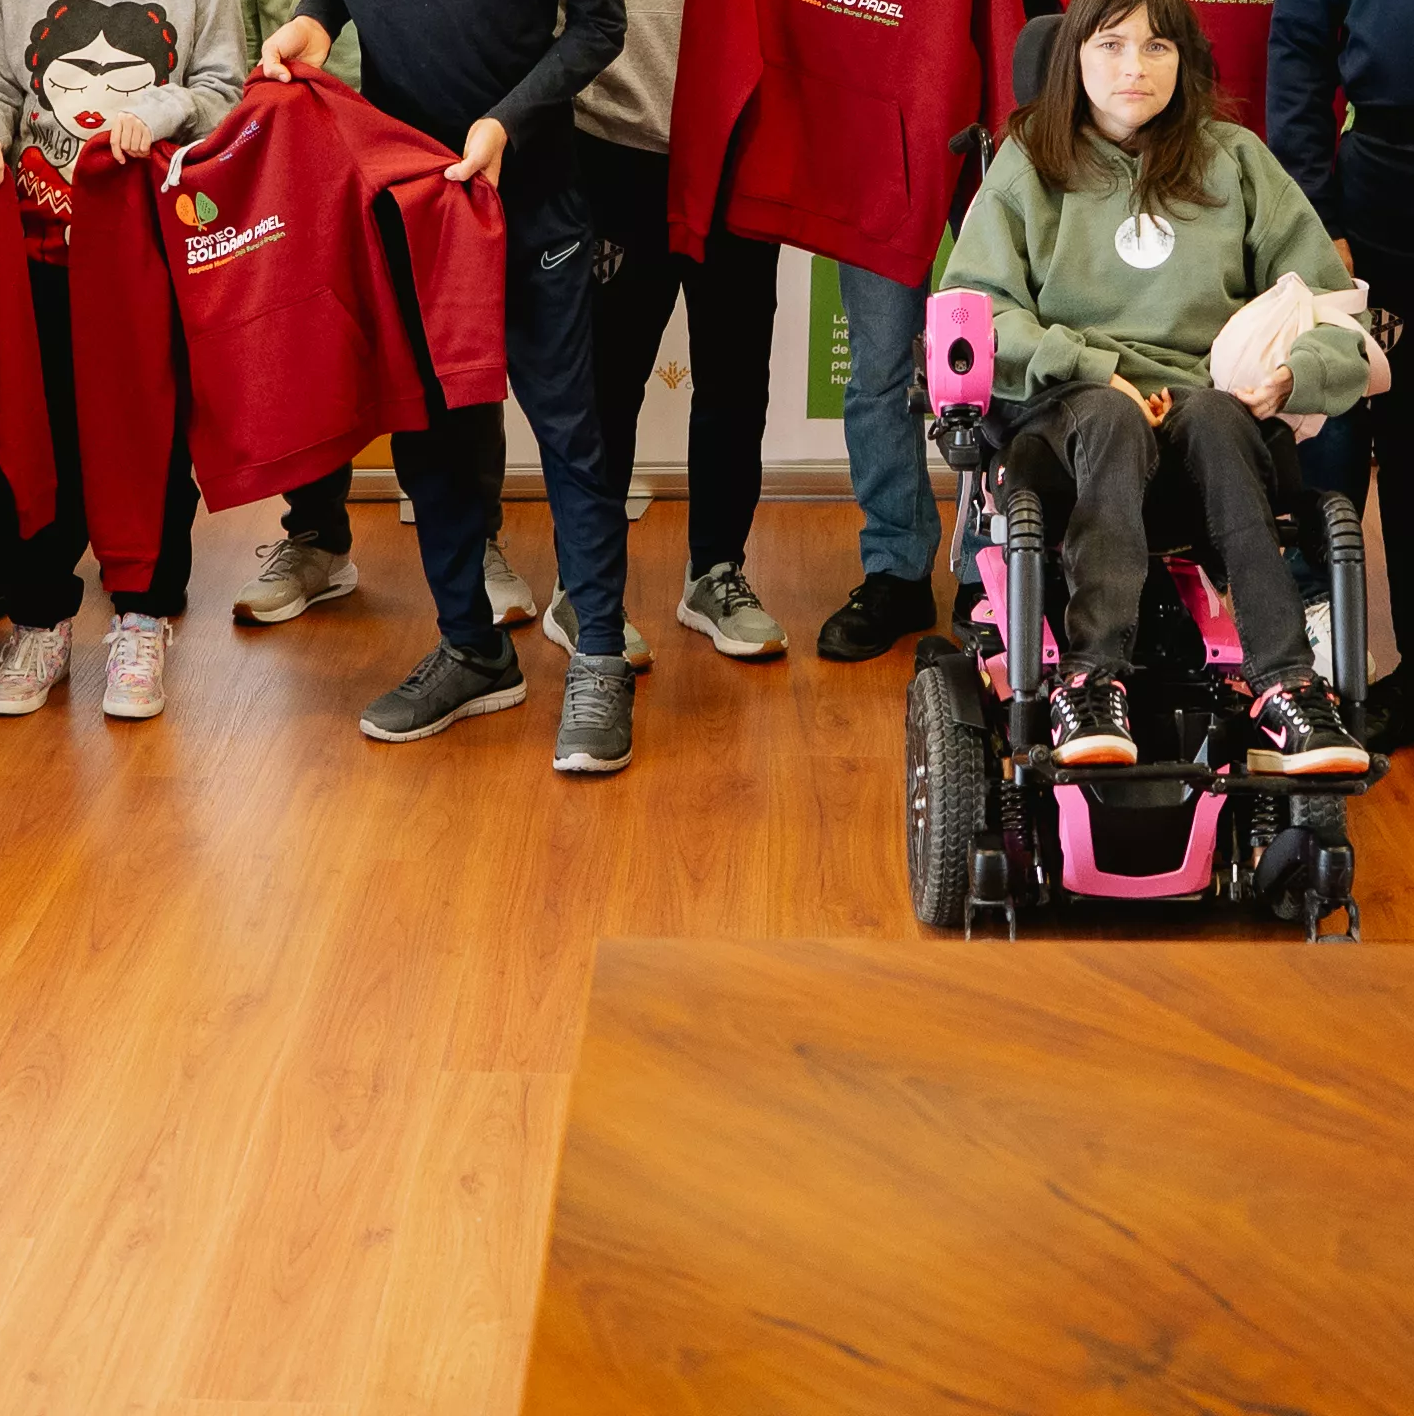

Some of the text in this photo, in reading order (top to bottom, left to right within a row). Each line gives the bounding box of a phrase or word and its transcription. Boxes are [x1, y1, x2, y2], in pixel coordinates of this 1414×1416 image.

[185, 226, 237, 251] TORNEO
[187, 214, 286, 265] SOLIDARIO PÁDEL
